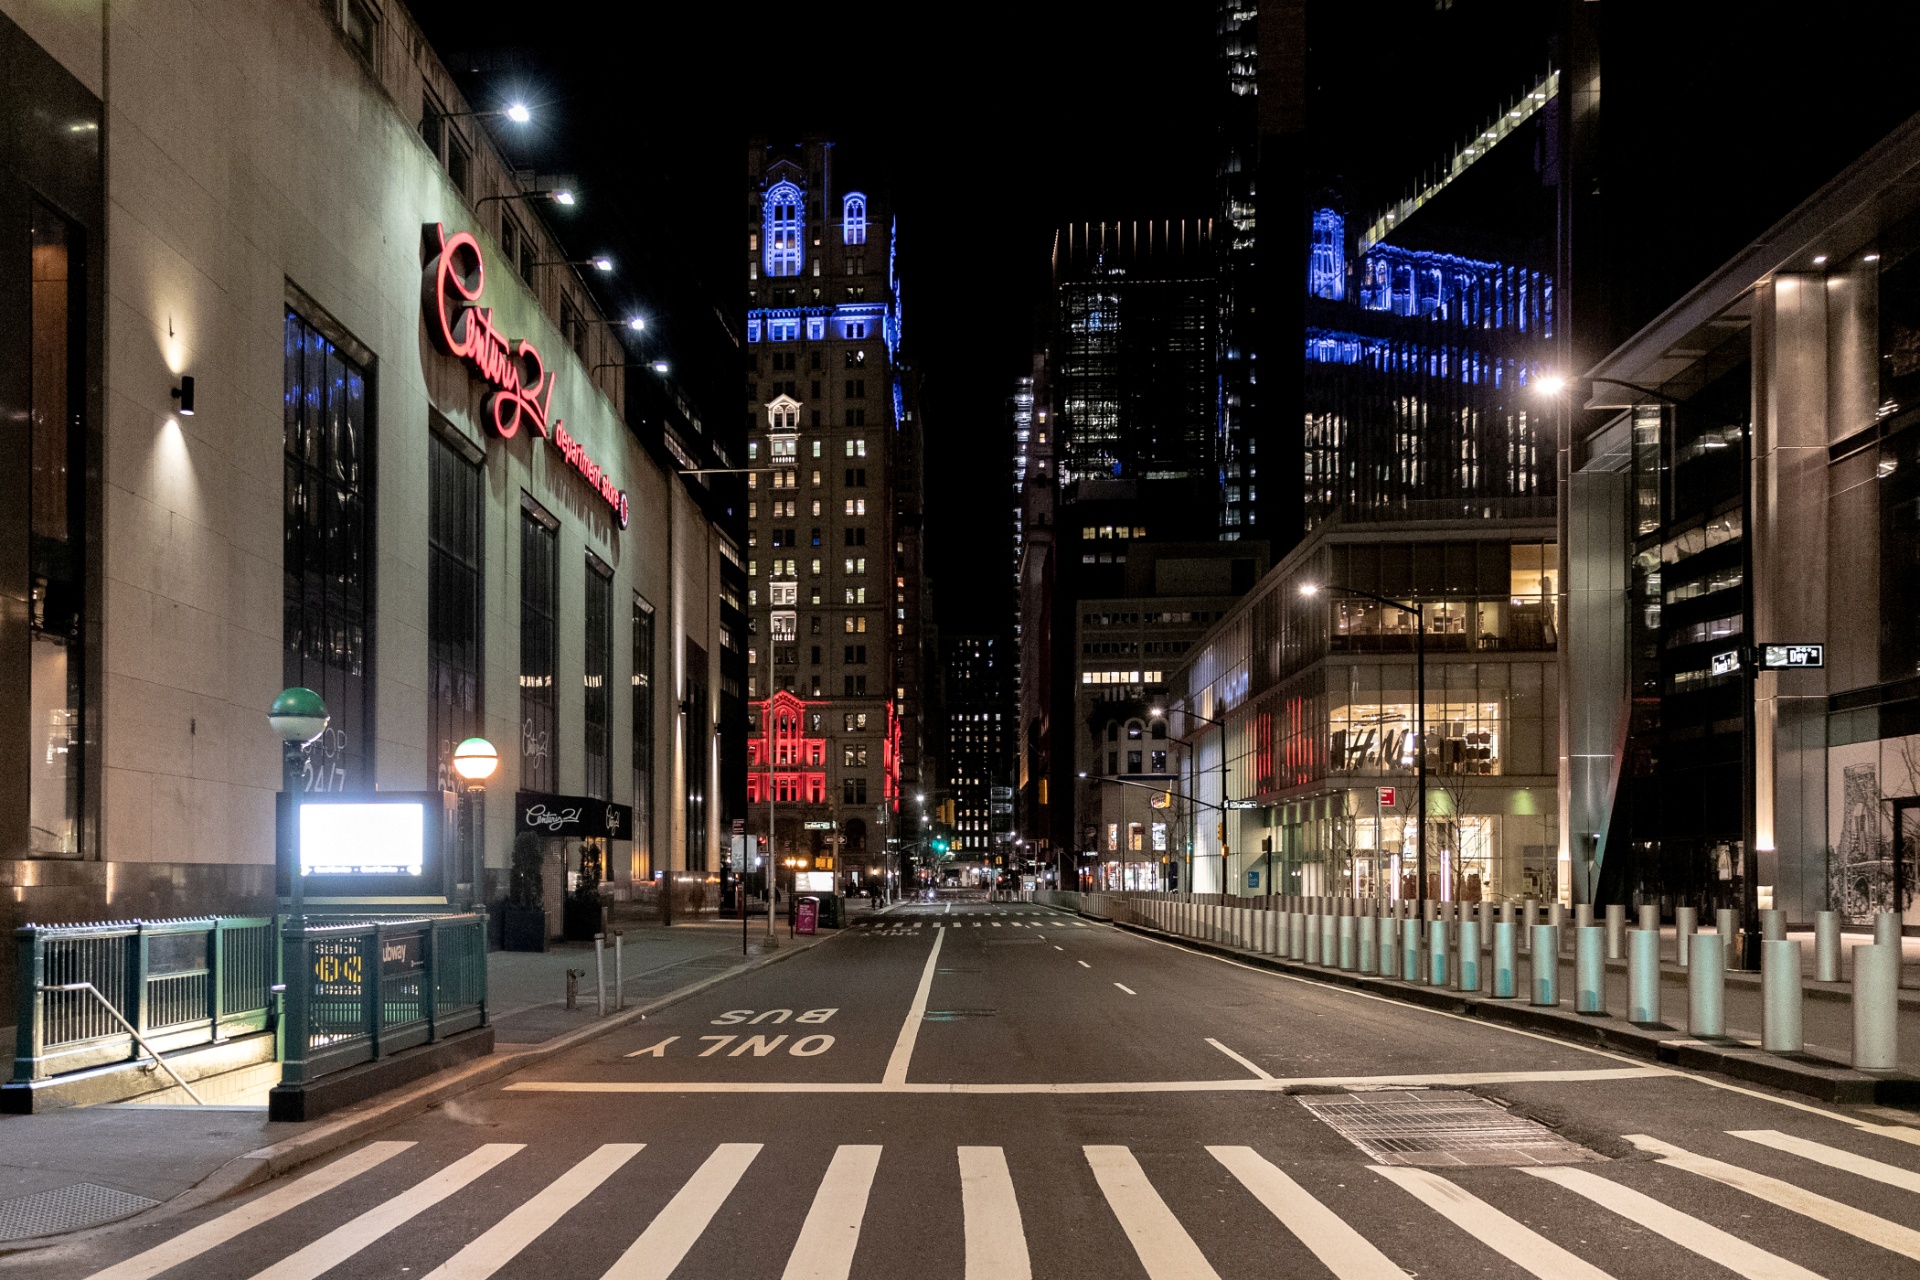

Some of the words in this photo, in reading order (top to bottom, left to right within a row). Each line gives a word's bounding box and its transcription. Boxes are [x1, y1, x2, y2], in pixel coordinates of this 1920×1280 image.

[437, 222, 521, 439] Century
[518, 338, 556, 437] 21
[555, 419, 602, 491] department
[601, 474, 620, 511] store
[1790, 649, 1808, 666] Dey
[1345, 728, 1409, 770] H&M
[526, 804, 563, 831] Century
[561, 807, 582, 823] 21
[382, 942, 407, 963] ubway
[710, 1008, 840, 1025] BUS
[623, 1035, 836, 1057] ONLY
